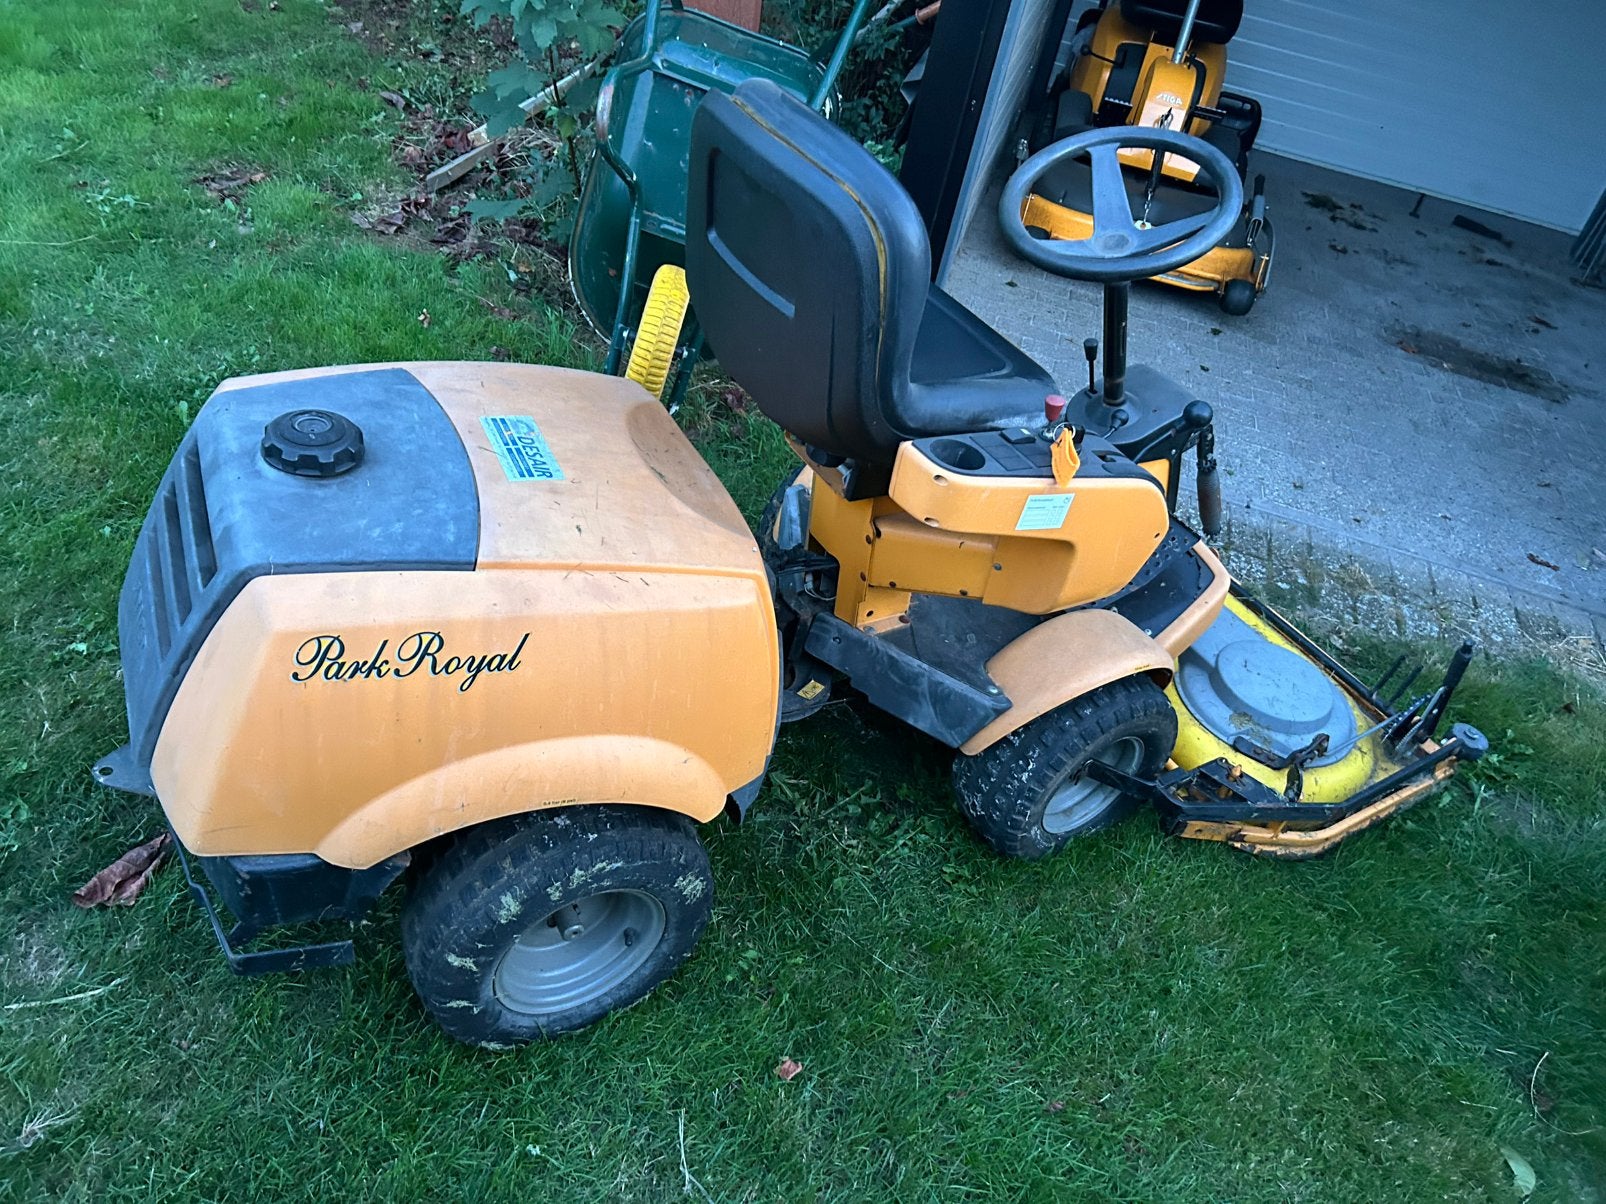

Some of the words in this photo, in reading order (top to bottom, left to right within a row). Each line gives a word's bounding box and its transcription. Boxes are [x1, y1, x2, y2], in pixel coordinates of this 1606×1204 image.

[516, 435, 553, 479] DESAIR
[291, 634, 391, 682] Park
[393, 631, 531, 693] Royal
